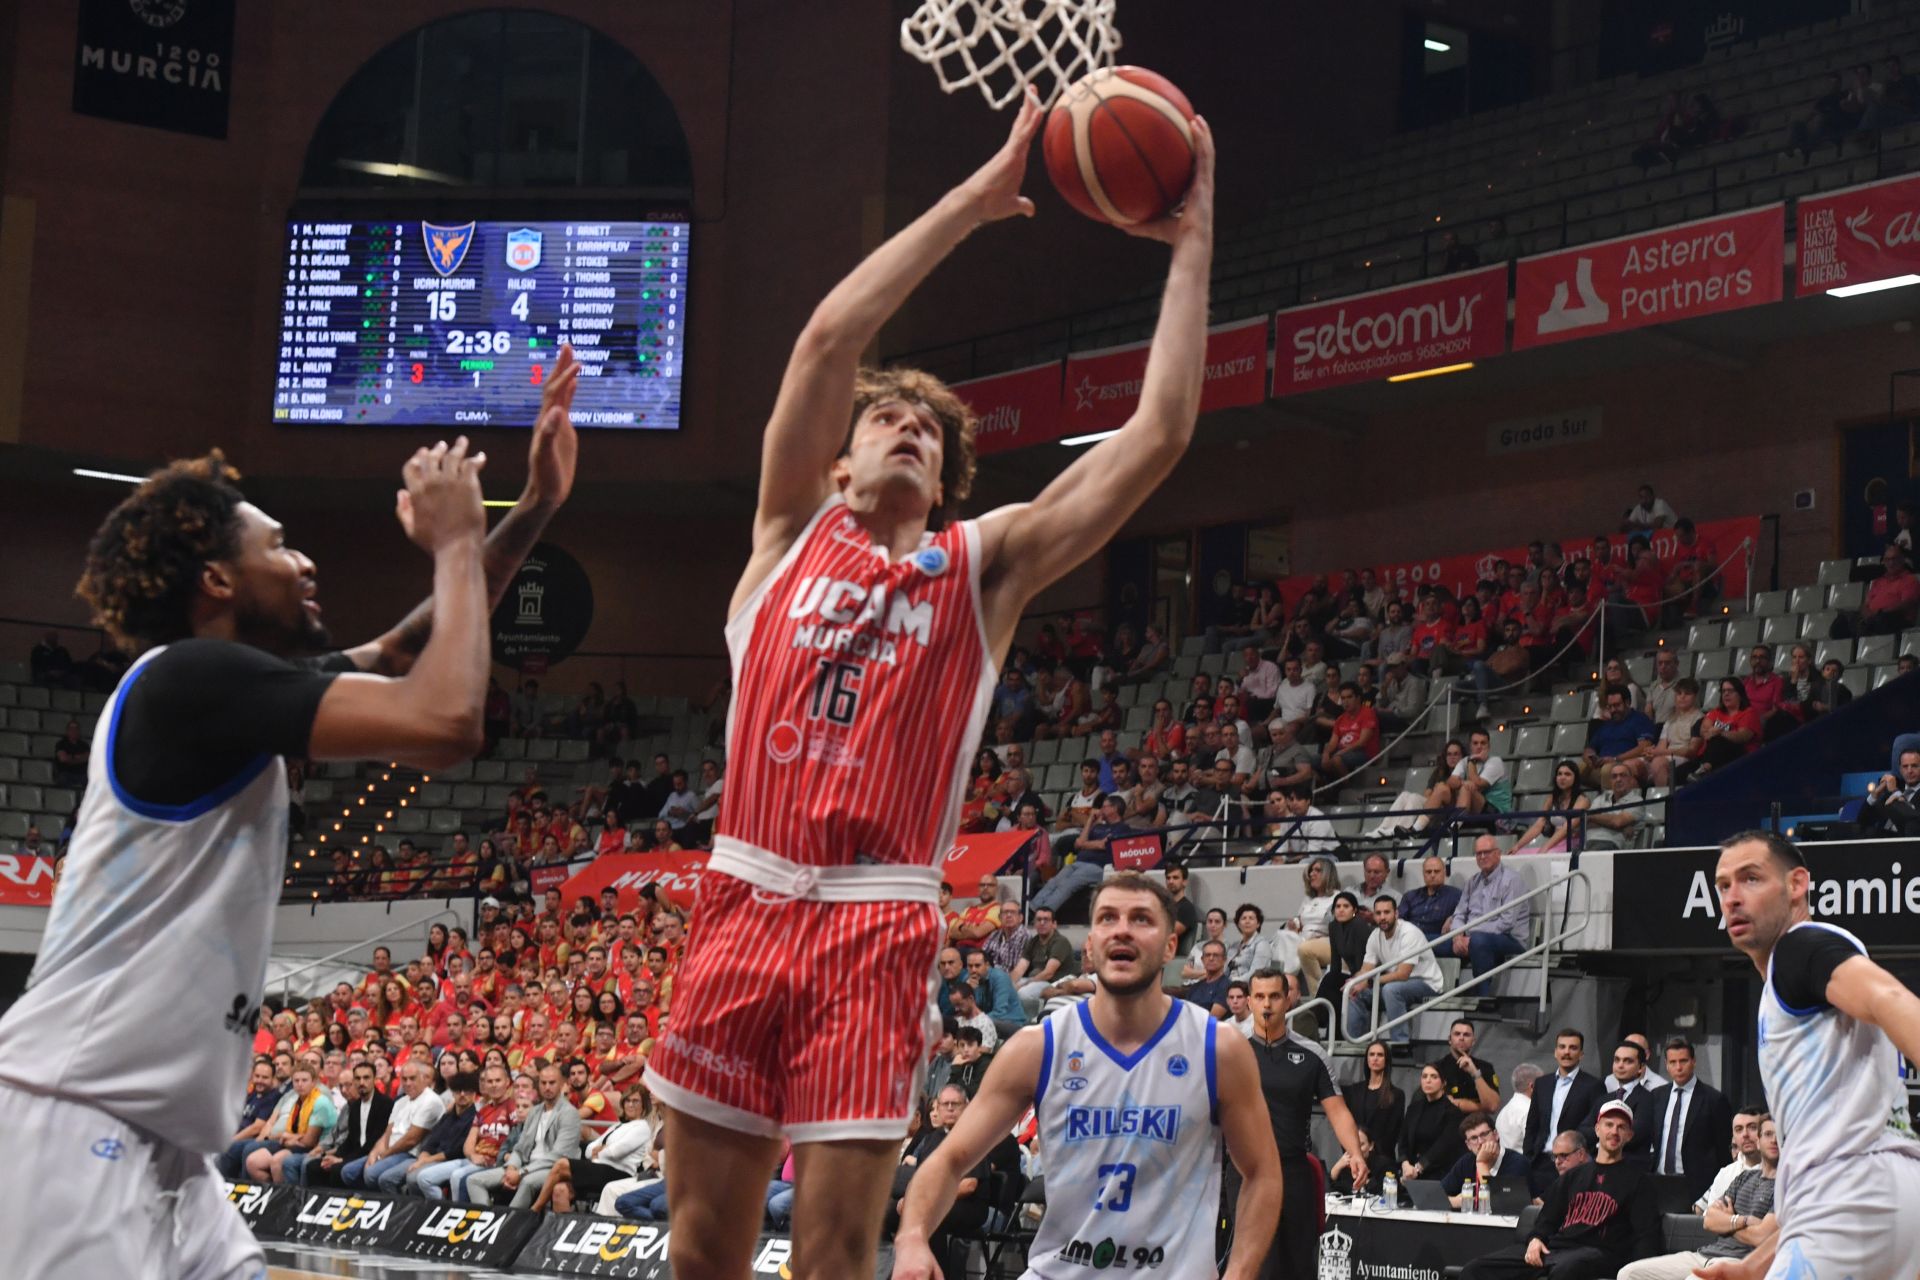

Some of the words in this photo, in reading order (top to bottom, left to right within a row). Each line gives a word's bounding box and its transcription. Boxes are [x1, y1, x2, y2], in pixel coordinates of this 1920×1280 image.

[157, 42, 220, 67] 1200
[82, 44, 222, 91] MURCIA
[1804, 208, 1835, 230] LLEGA
[293, 224, 298, 235] 1
[315, 224, 352, 235] FORREST
[1804, 227, 1837, 249] HASTA
[291, 239, 298, 250] 2
[672, 241, 679, 252] 0
[393, 254, 401, 266] 0
[564, 256, 571, 267] 3
[576, 256, 608, 267] STOKES
[671, 257, 678, 268] 2
[1622, 231, 1736, 277] Asterra
[1803, 245, 1837, 268] DONDE
[288, 269, 296, 281] 6
[393, 269, 400, 281] 0
[563, 272, 570, 283] 4
[575, 272, 610, 283] THOMAS
[670, 272, 677, 283] 0
[1802, 261, 1847, 287] QUIERAS
[286, 285, 296, 296] 12
[392, 285, 399, 296] 3
[413, 278, 439, 290] UCAM
[441, 278, 476, 290] MURCIA
[562, 287, 569, 298] 7
[574, 287, 615, 298] EDWARDS
[670, 287, 677, 298] 0
[1621, 267, 1753, 320] Partners
[310, 300, 331, 311] FALK
[426, 291, 457, 321] 15
[510, 292, 529, 321] 4
[561, 303, 569, 314] 11
[573, 303, 614, 314] DIMITROV
[668, 303, 676, 314] 0
[306, 316, 328, 327] CATE
[390, 316, 397, 327] 2
[559, 319, 569, 330] 12
[572, 319, 614, 330] GEORGIEV
[668, 319, 675, 330] 0
[1293, 294, 1482, 364] setcomur
[306, 331, 317, 342] DE
[318, 331, 329, 342] LA
[330, 331, 357, 342] TORRE
[388, 331, 396, 342] 0
[446, 330, 511, 354] 2:36
[571, 334, 601, 345] VASOV
[667, 335, 674, 346] 0
[281, 347, 292, 358] 21
[387, 347, 394, 358] 3
[666, 351, 673, 362] 0
[279, 362, 291, 373] 22
[386, 362, 393, 373] 0
[411, 363, 424, 384] 3
[530, 364, 543, 385] 3
[666, 367, 672, 377] 0
[1205, 356, 1257, 381] VANTE
[1317, 367, 1330, 378] en
[278, 377, 290, 389] 24
[302, 377, 327, 389] HICKS
[385, 377, 392, 389] 0
[473, 371, 480, 388] 1
[278, 393, 288, 404] 31
[384, 393, 391, 404] 0
[310, 409, 343, 419] ALONSO
[455, 411, 489, 421] CUMA
[1500, 424, 1554, 446] Grada
[1562, 419, 1588, 437] Sur
[787, 576, 934, 647] UCAM
[792, 623, 897, 666] MURCIA
[808, 657, 865, 727] 16
[1119, 845, 1155, 859] MÓDULO
[1067, 1106, 1179, 1142] RILSKI
[296, 1194, 394, 1231] LIBERA
[417, 1206, 507, 1245] LIBERA
[284, 1226, 379, 1246] TELECOM
[552, 1219, 671, 1262] LIBERA
[405, 1240, 486, 1261] TELECOM
[541, 1257, 660, 1279] TELECOM
[1356, 1259, 1440, 1280] Ayuntamiento
